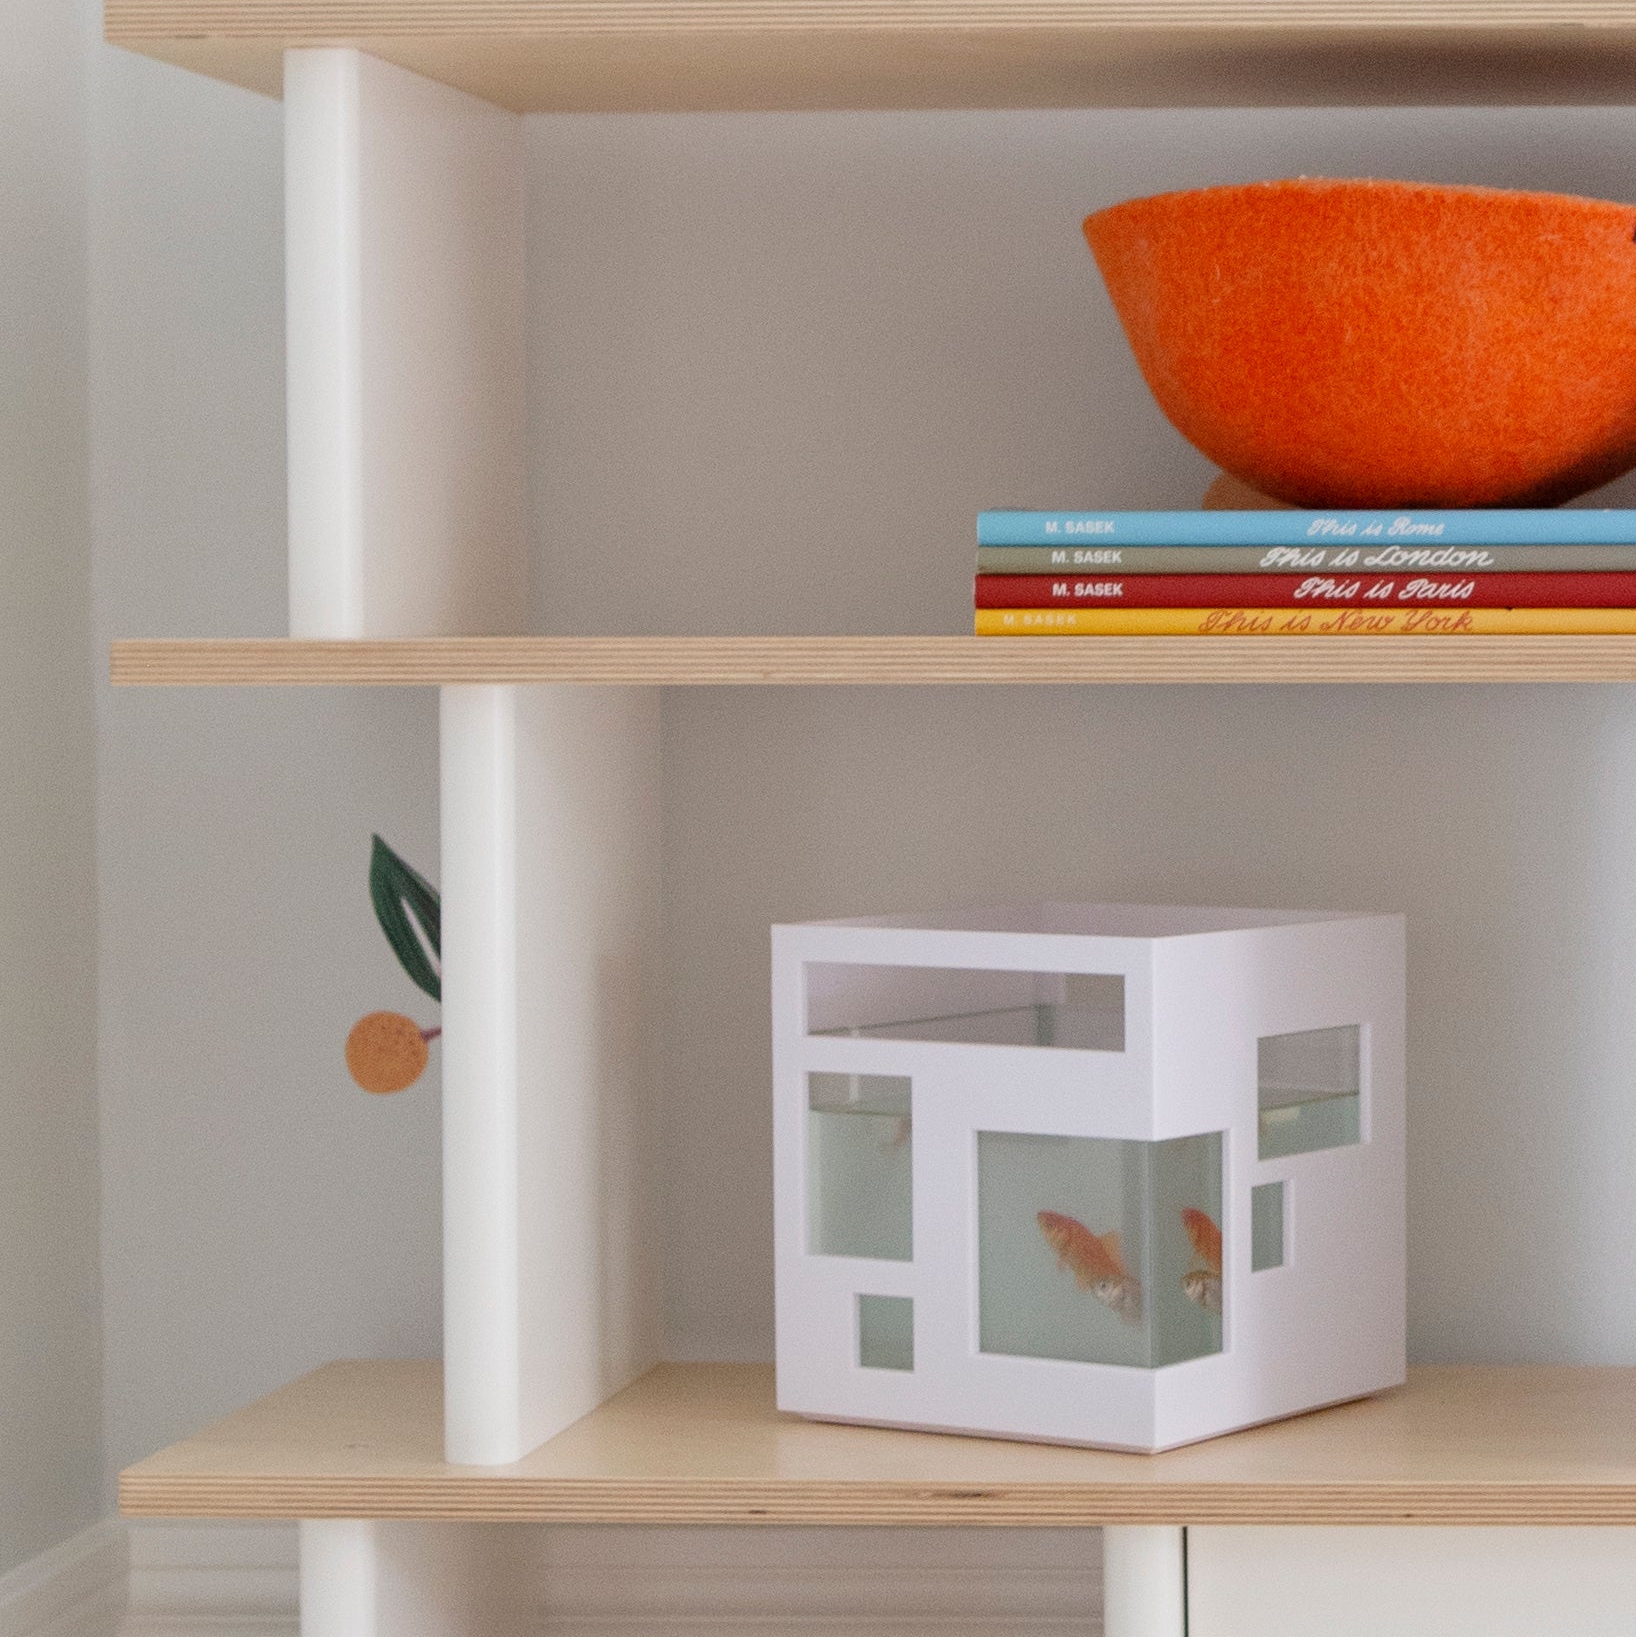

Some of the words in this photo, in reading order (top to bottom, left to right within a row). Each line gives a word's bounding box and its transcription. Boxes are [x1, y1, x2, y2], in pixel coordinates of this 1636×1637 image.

[1045, 521, 1060, 534] M.
[1065, 521, 1115, 534] SASEK
[1306, 518, 1357, 536] This
[1360, 520, 1383, 536] is
[1387, 516, 1445, 536] Rome
[1051, 551, 1069, 564] M.
[1073, 551, 1122, 564] SASEK
[1259, 546, 1327, 568] This
[1328, 548, 1360, 567] is
[1364, 545, 1494, 567] London
[1052, 583, 1070, 596] M.
[1074, 583, 1123, 596] SASEK
[1293, 576, 1361, 599] This
[1363, 579, 1395, 599] is
[1398, 578, 1475, 599] Paris
[1023, 614, 1077, 625] SASEK
[1199, 610, 1273, 632] This
[1280, 613, 1312, 631] is
[1320, 610, 1395, 631] New
[1400, 610, 1473, 632] York
